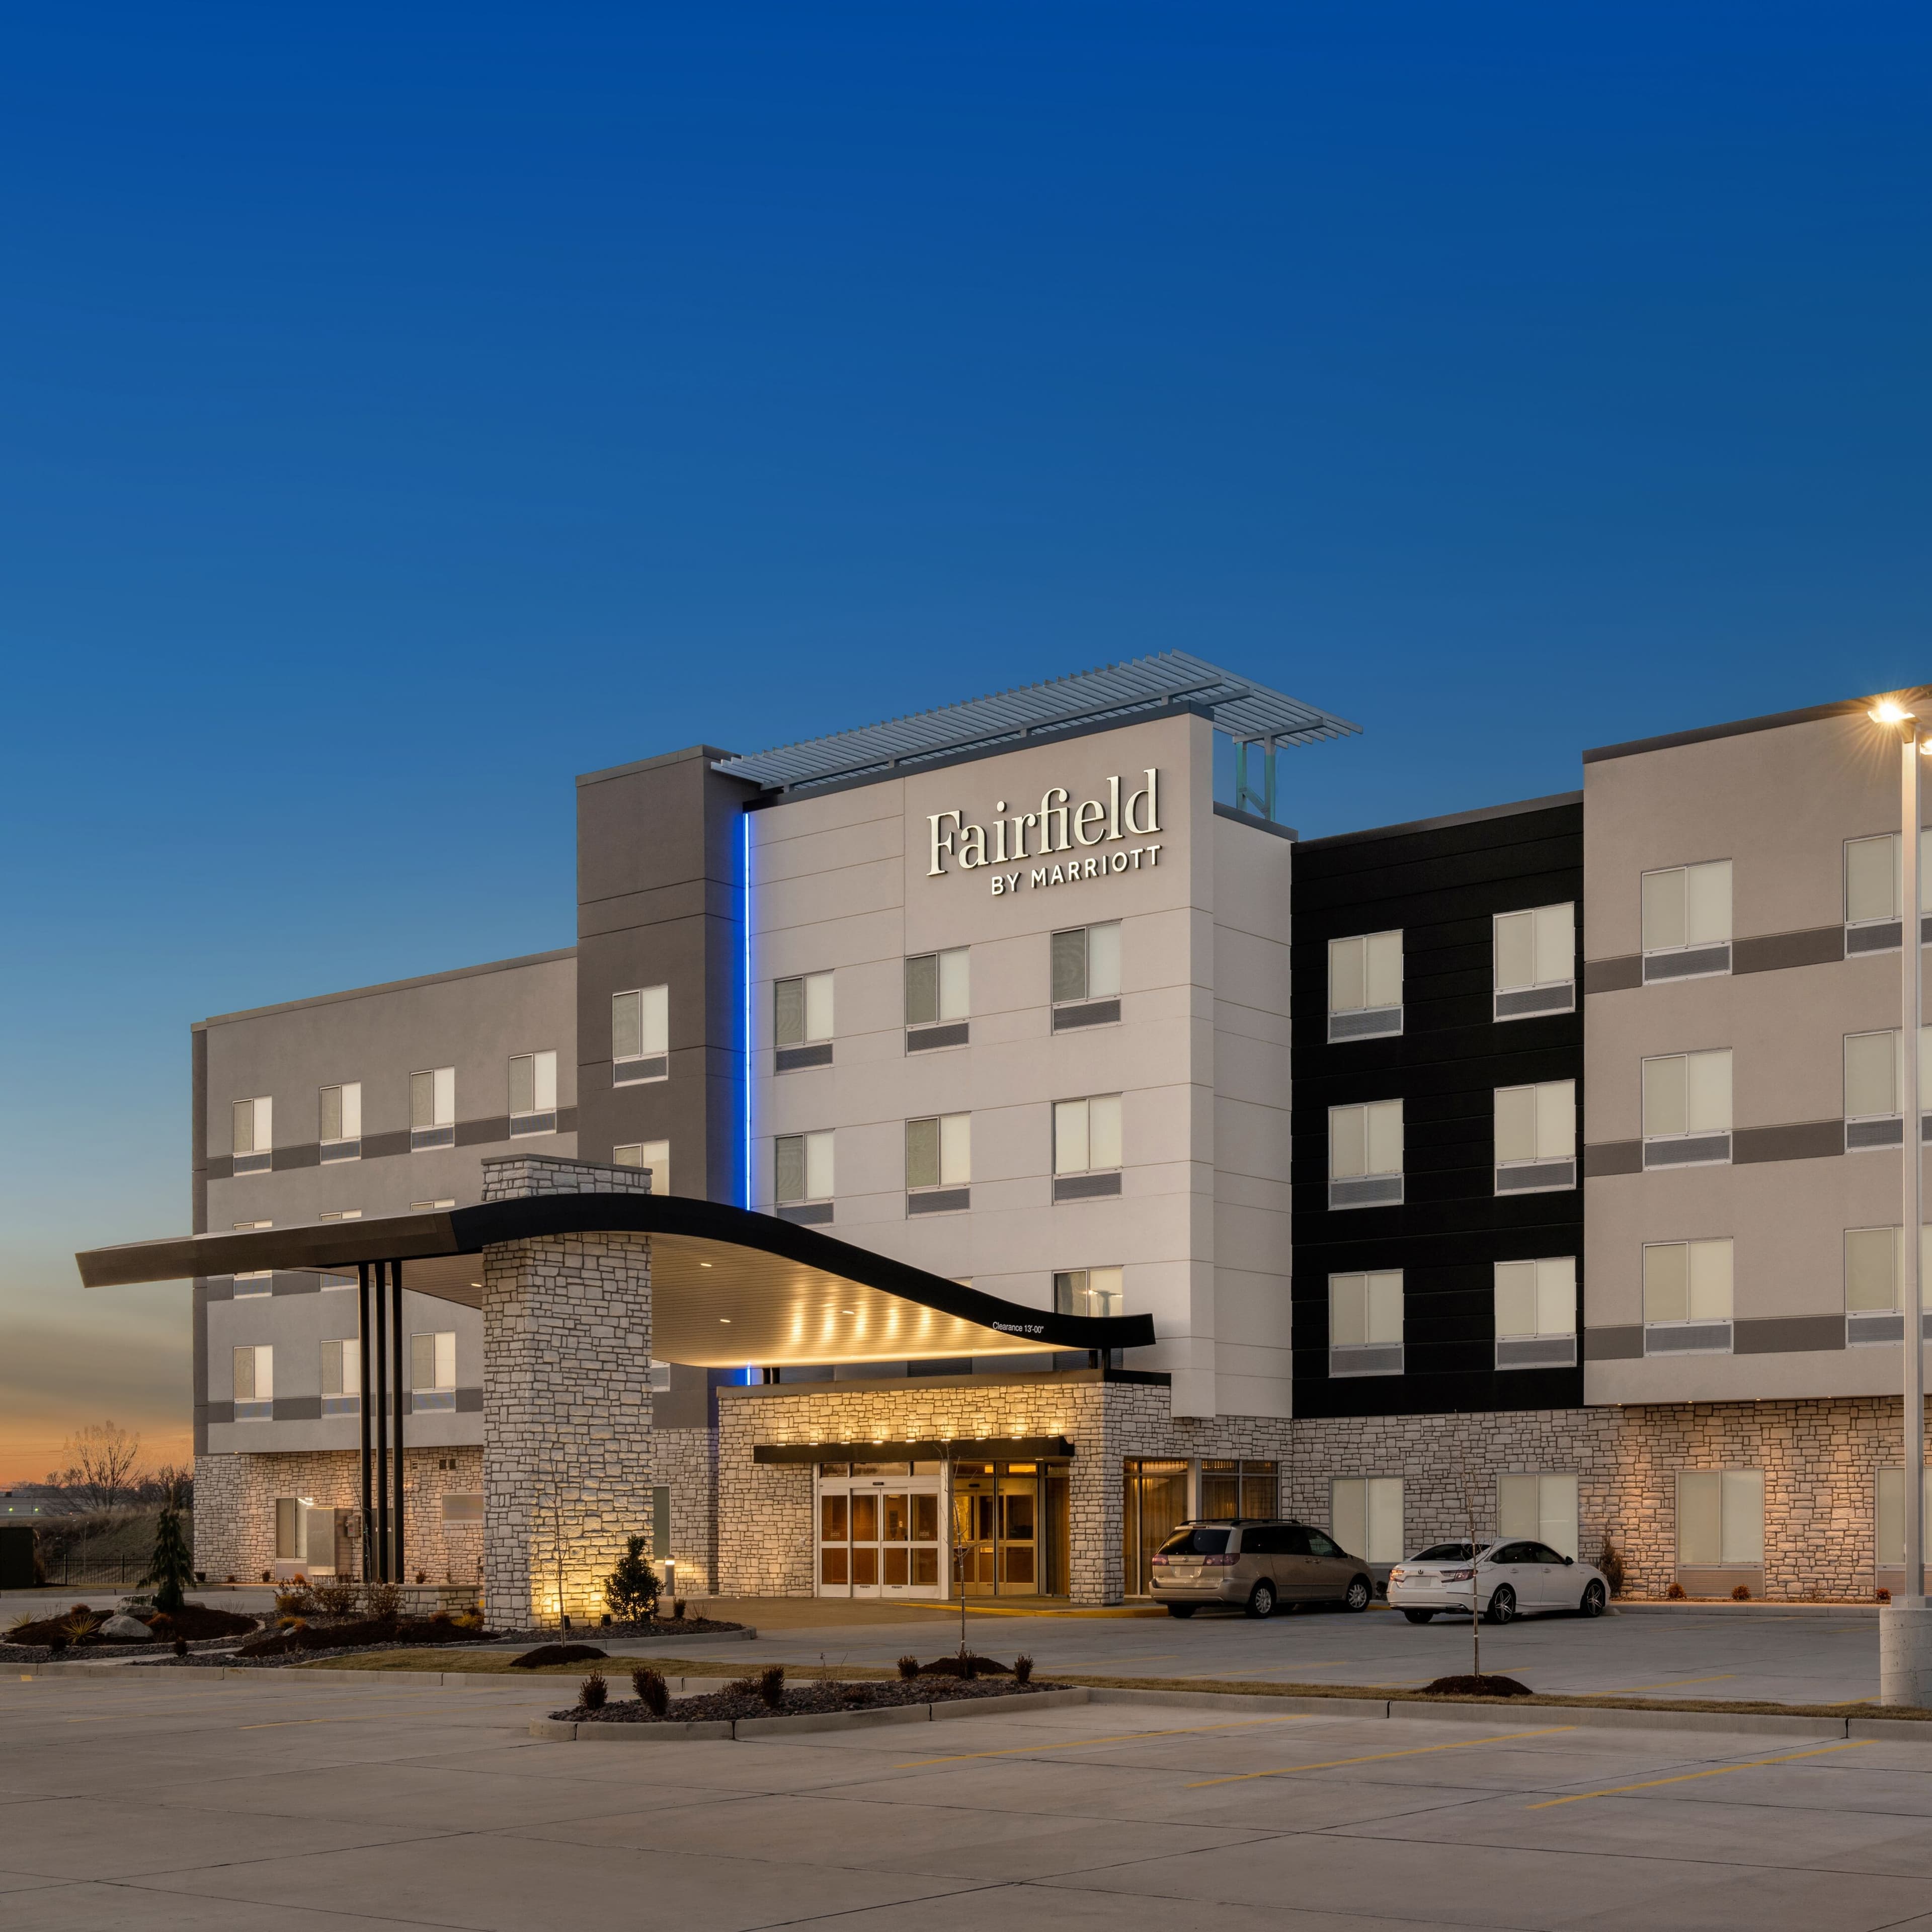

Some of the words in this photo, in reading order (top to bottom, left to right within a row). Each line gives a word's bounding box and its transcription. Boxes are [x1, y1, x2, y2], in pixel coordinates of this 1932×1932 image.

[926, 768, 1162, 876] Fairfield
[991, 872, 1021, 897] BY
[1031, 845, 1162, 889] MARRIOTT
[993, 1321, 1023, 1332] Clearance
